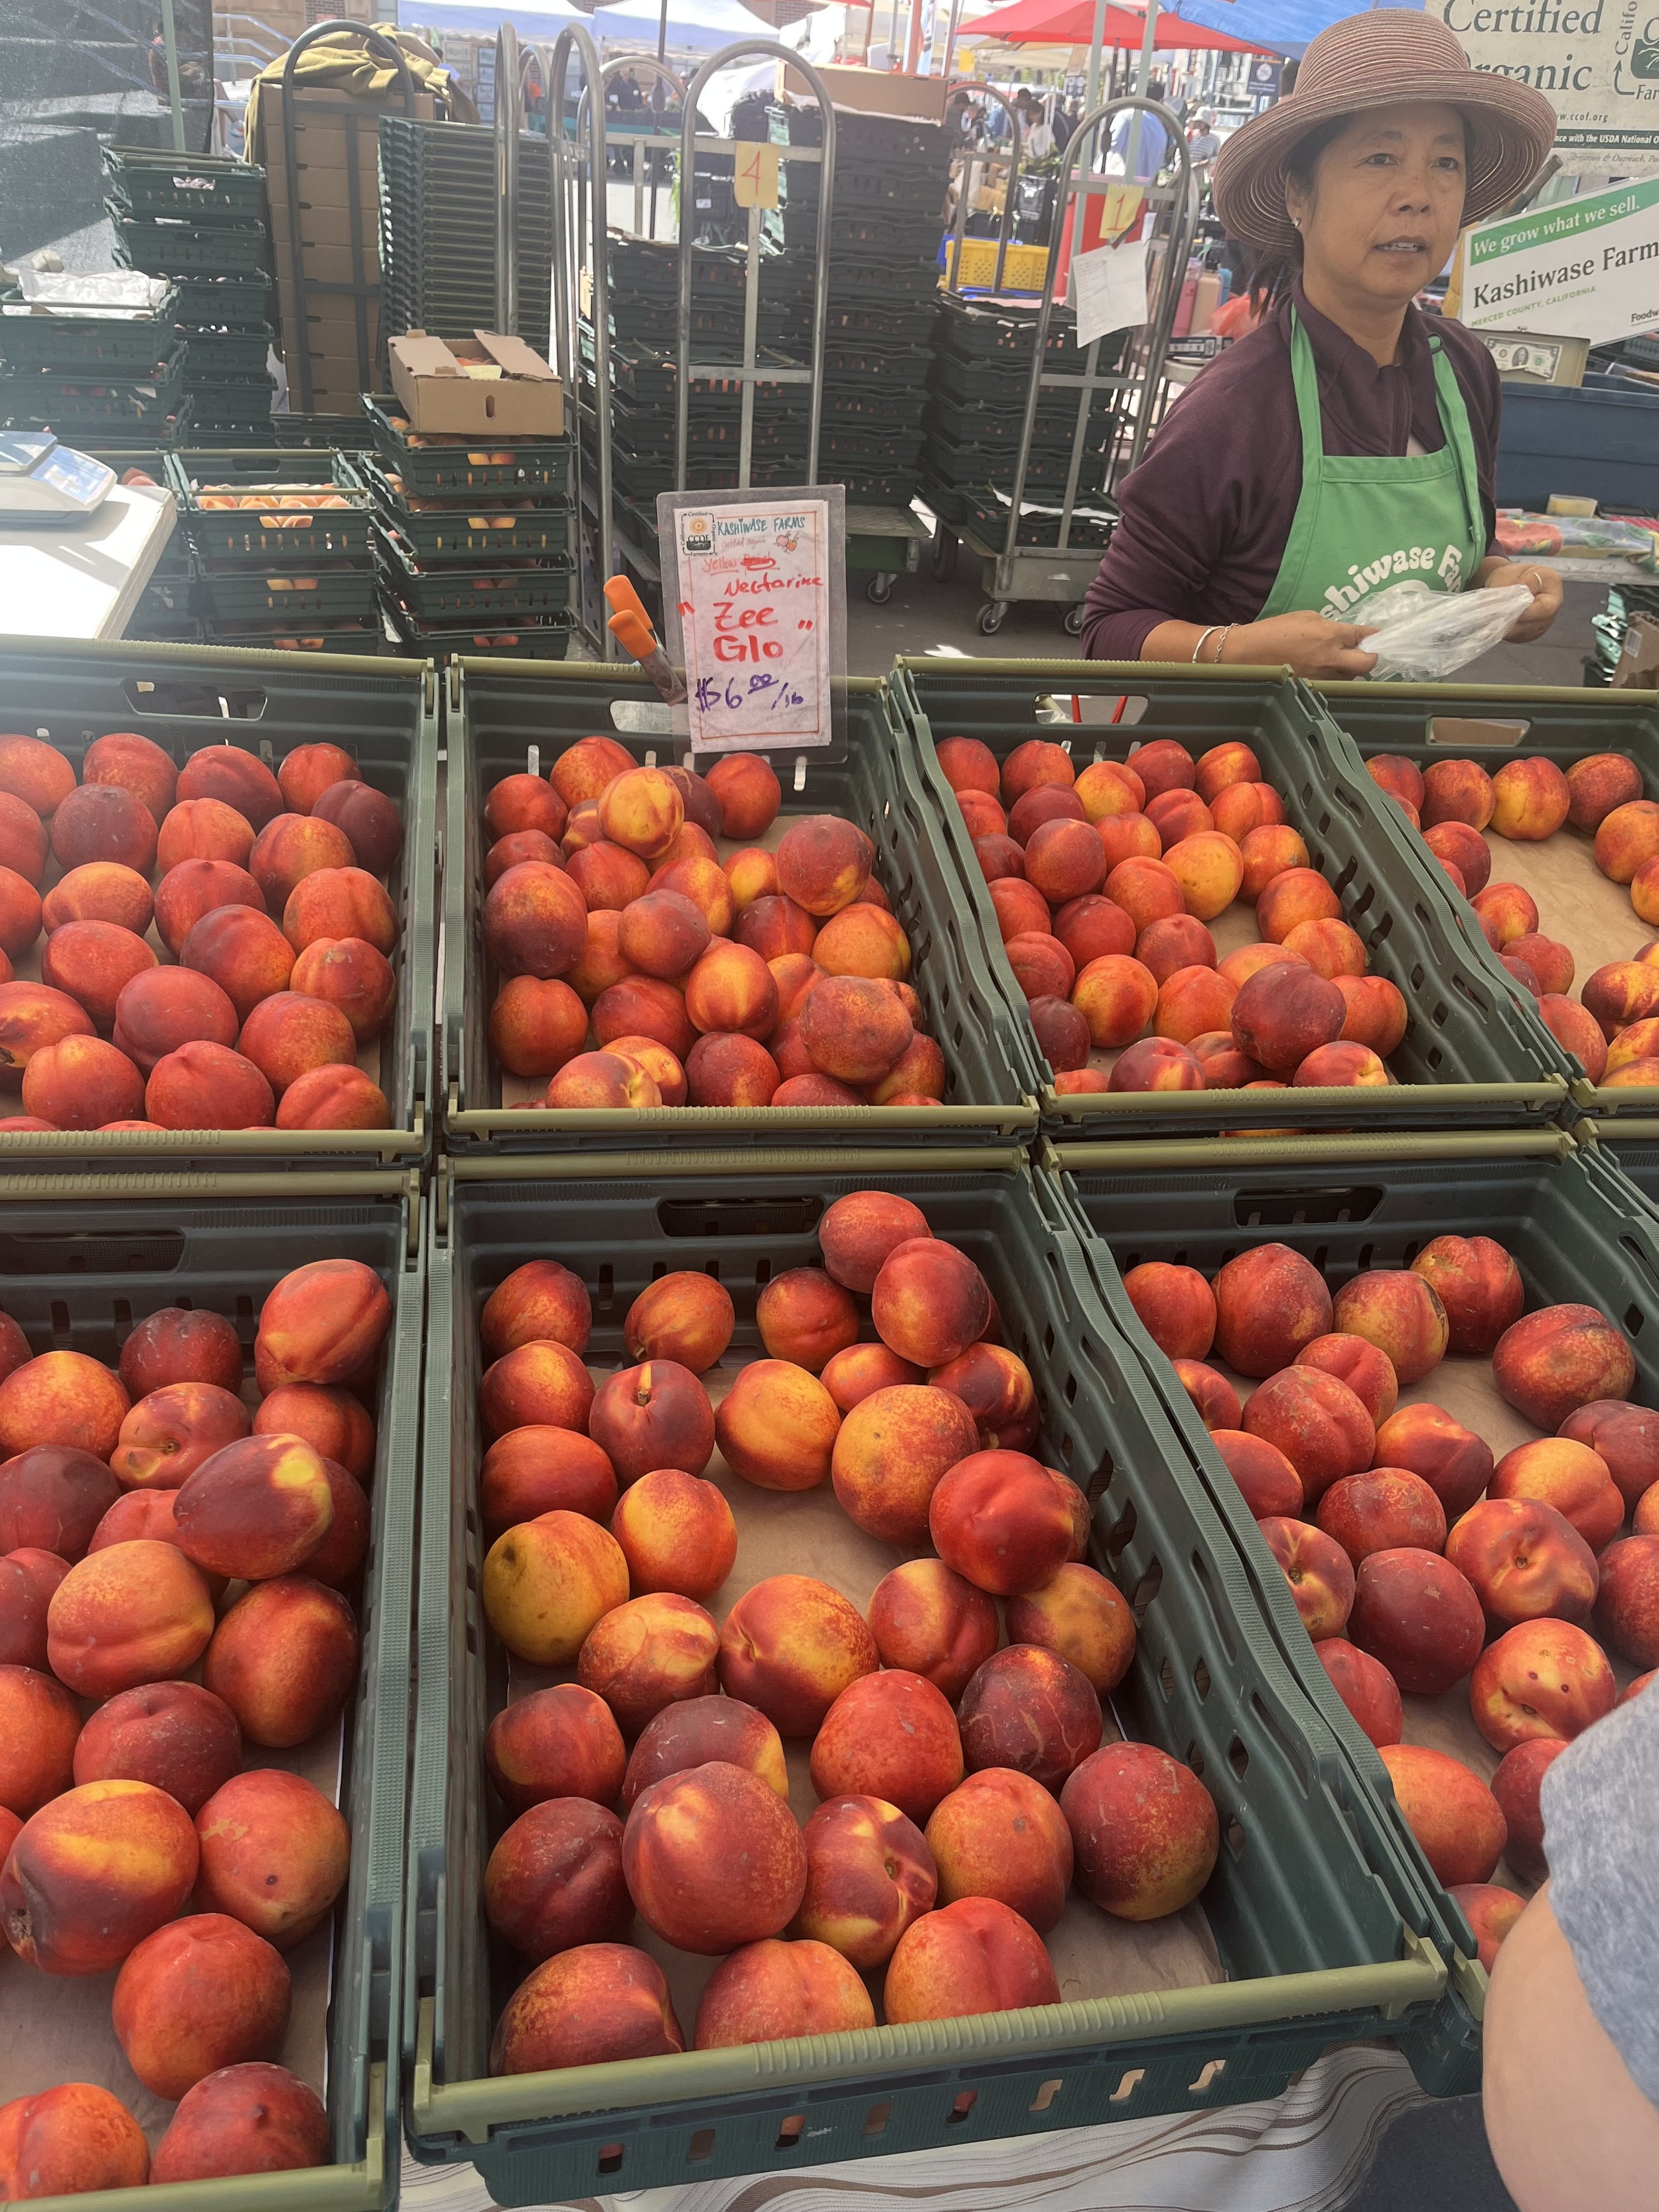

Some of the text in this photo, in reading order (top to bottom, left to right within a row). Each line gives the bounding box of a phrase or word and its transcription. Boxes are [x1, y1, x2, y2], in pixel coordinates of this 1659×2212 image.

[1443, 0, 1605, 34] Certified
[1569, 133, 1584, 143] with
[1586, 134, 1597, 143] the
[1599, 135, 1619, 143] USDA
[1621, 135, 1652, 144] National
[741, 151, 760, 196] 4
[1106, 193, 1126, 231] 1
[1474, 195, 1640, 257] We grow what we sell.
[1473, 259, 1594, 309] Kashiwase
[1471, 312, 1504, 327] MERCED
[1546, 286, 1596, 306] CALIFORNIA
[774, 516, 805, 532] FARMS
[724, 572, 824, 597] Nectarine
